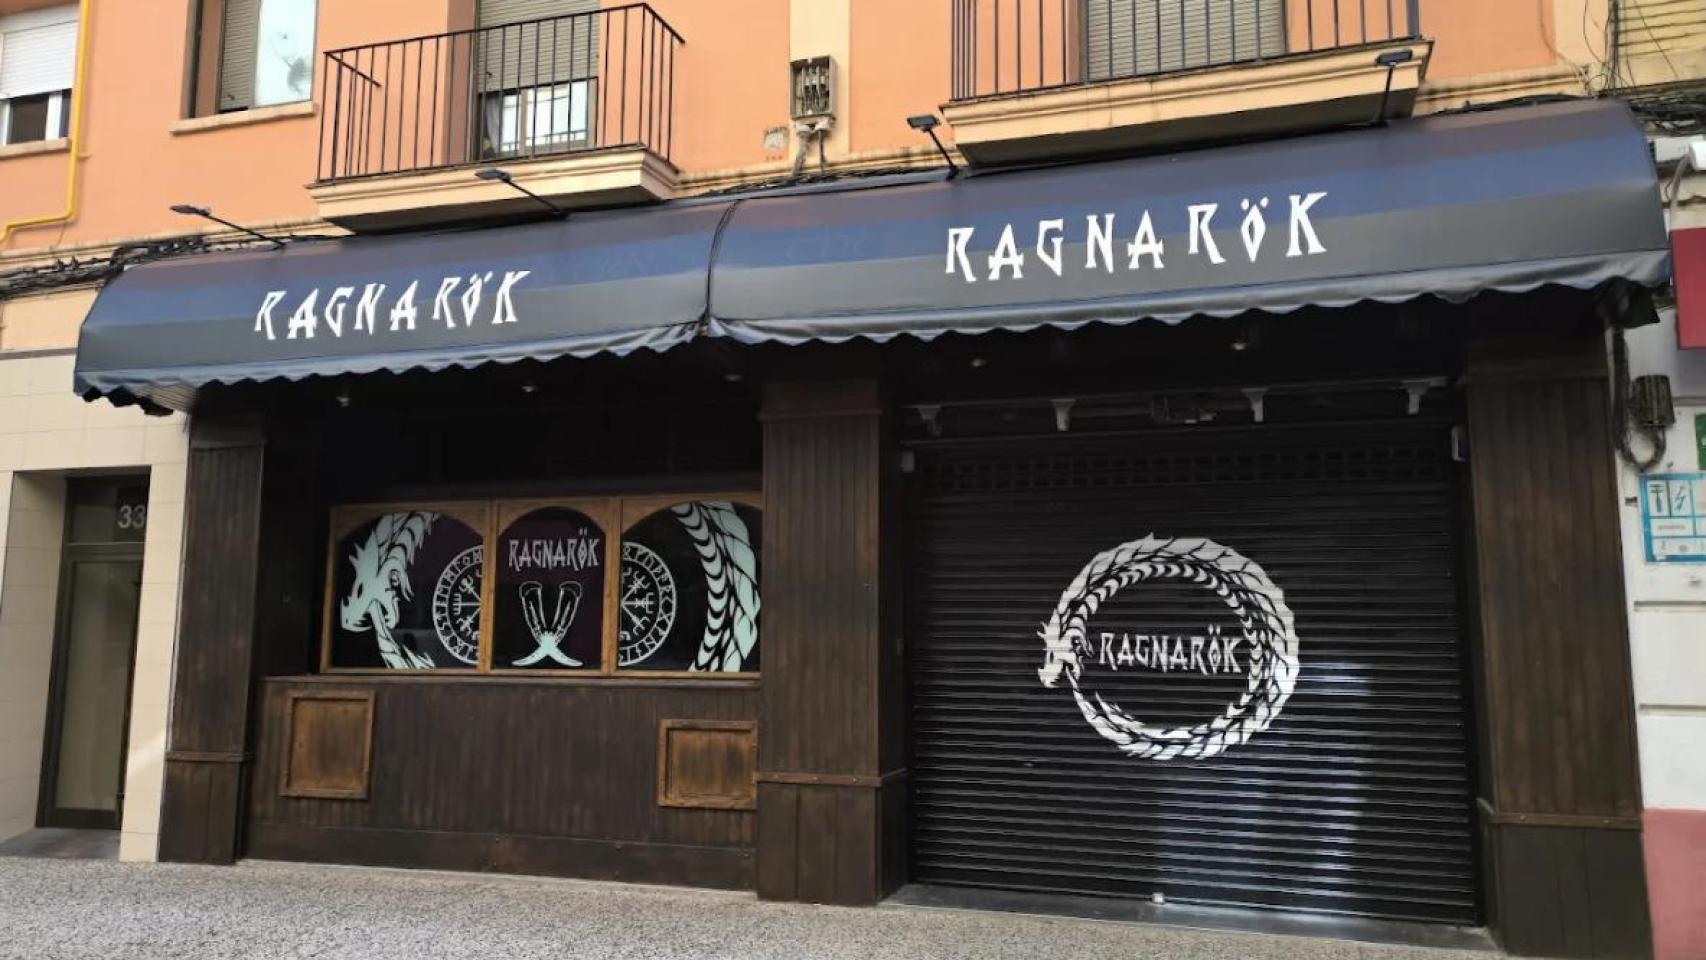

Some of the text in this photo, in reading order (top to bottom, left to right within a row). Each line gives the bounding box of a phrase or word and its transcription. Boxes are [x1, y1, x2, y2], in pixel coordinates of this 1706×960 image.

[945, 191, 1328, 283] RAGNARÖK
[254, 270, 531, 341] RAGNARÖK
[118, 505, 146, 528] 33
[508, 528, 600, 572] RAGNARÖK
[1098, 623, 1243, 676] RAGNARÖK
